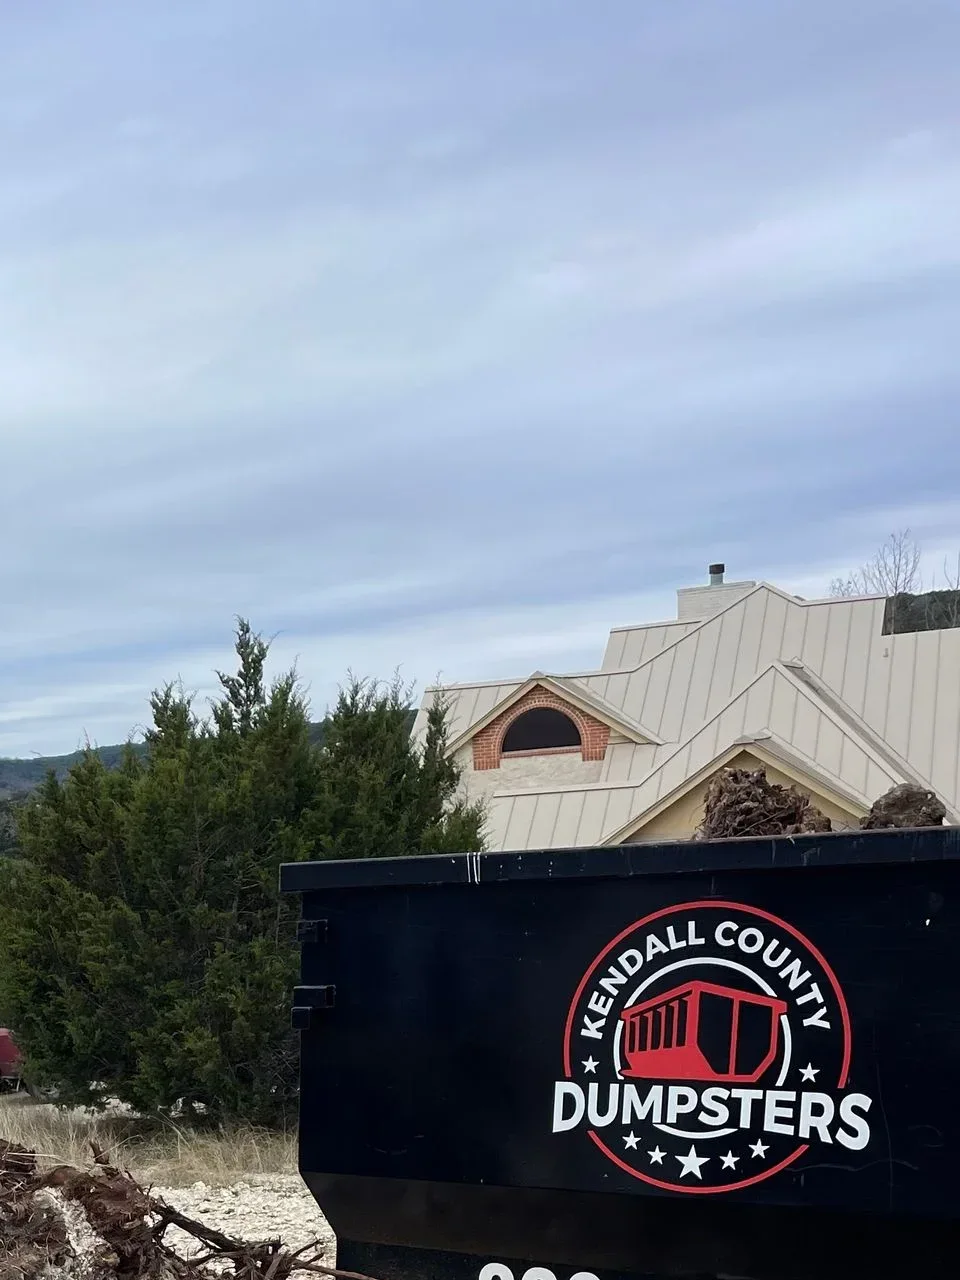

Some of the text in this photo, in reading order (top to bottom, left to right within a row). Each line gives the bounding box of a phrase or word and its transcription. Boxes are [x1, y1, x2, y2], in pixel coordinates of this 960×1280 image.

[580, 920, 830, 1039] KENDALL COUNTY
[552, 1081, 872, 1150] DUMPSTERS
